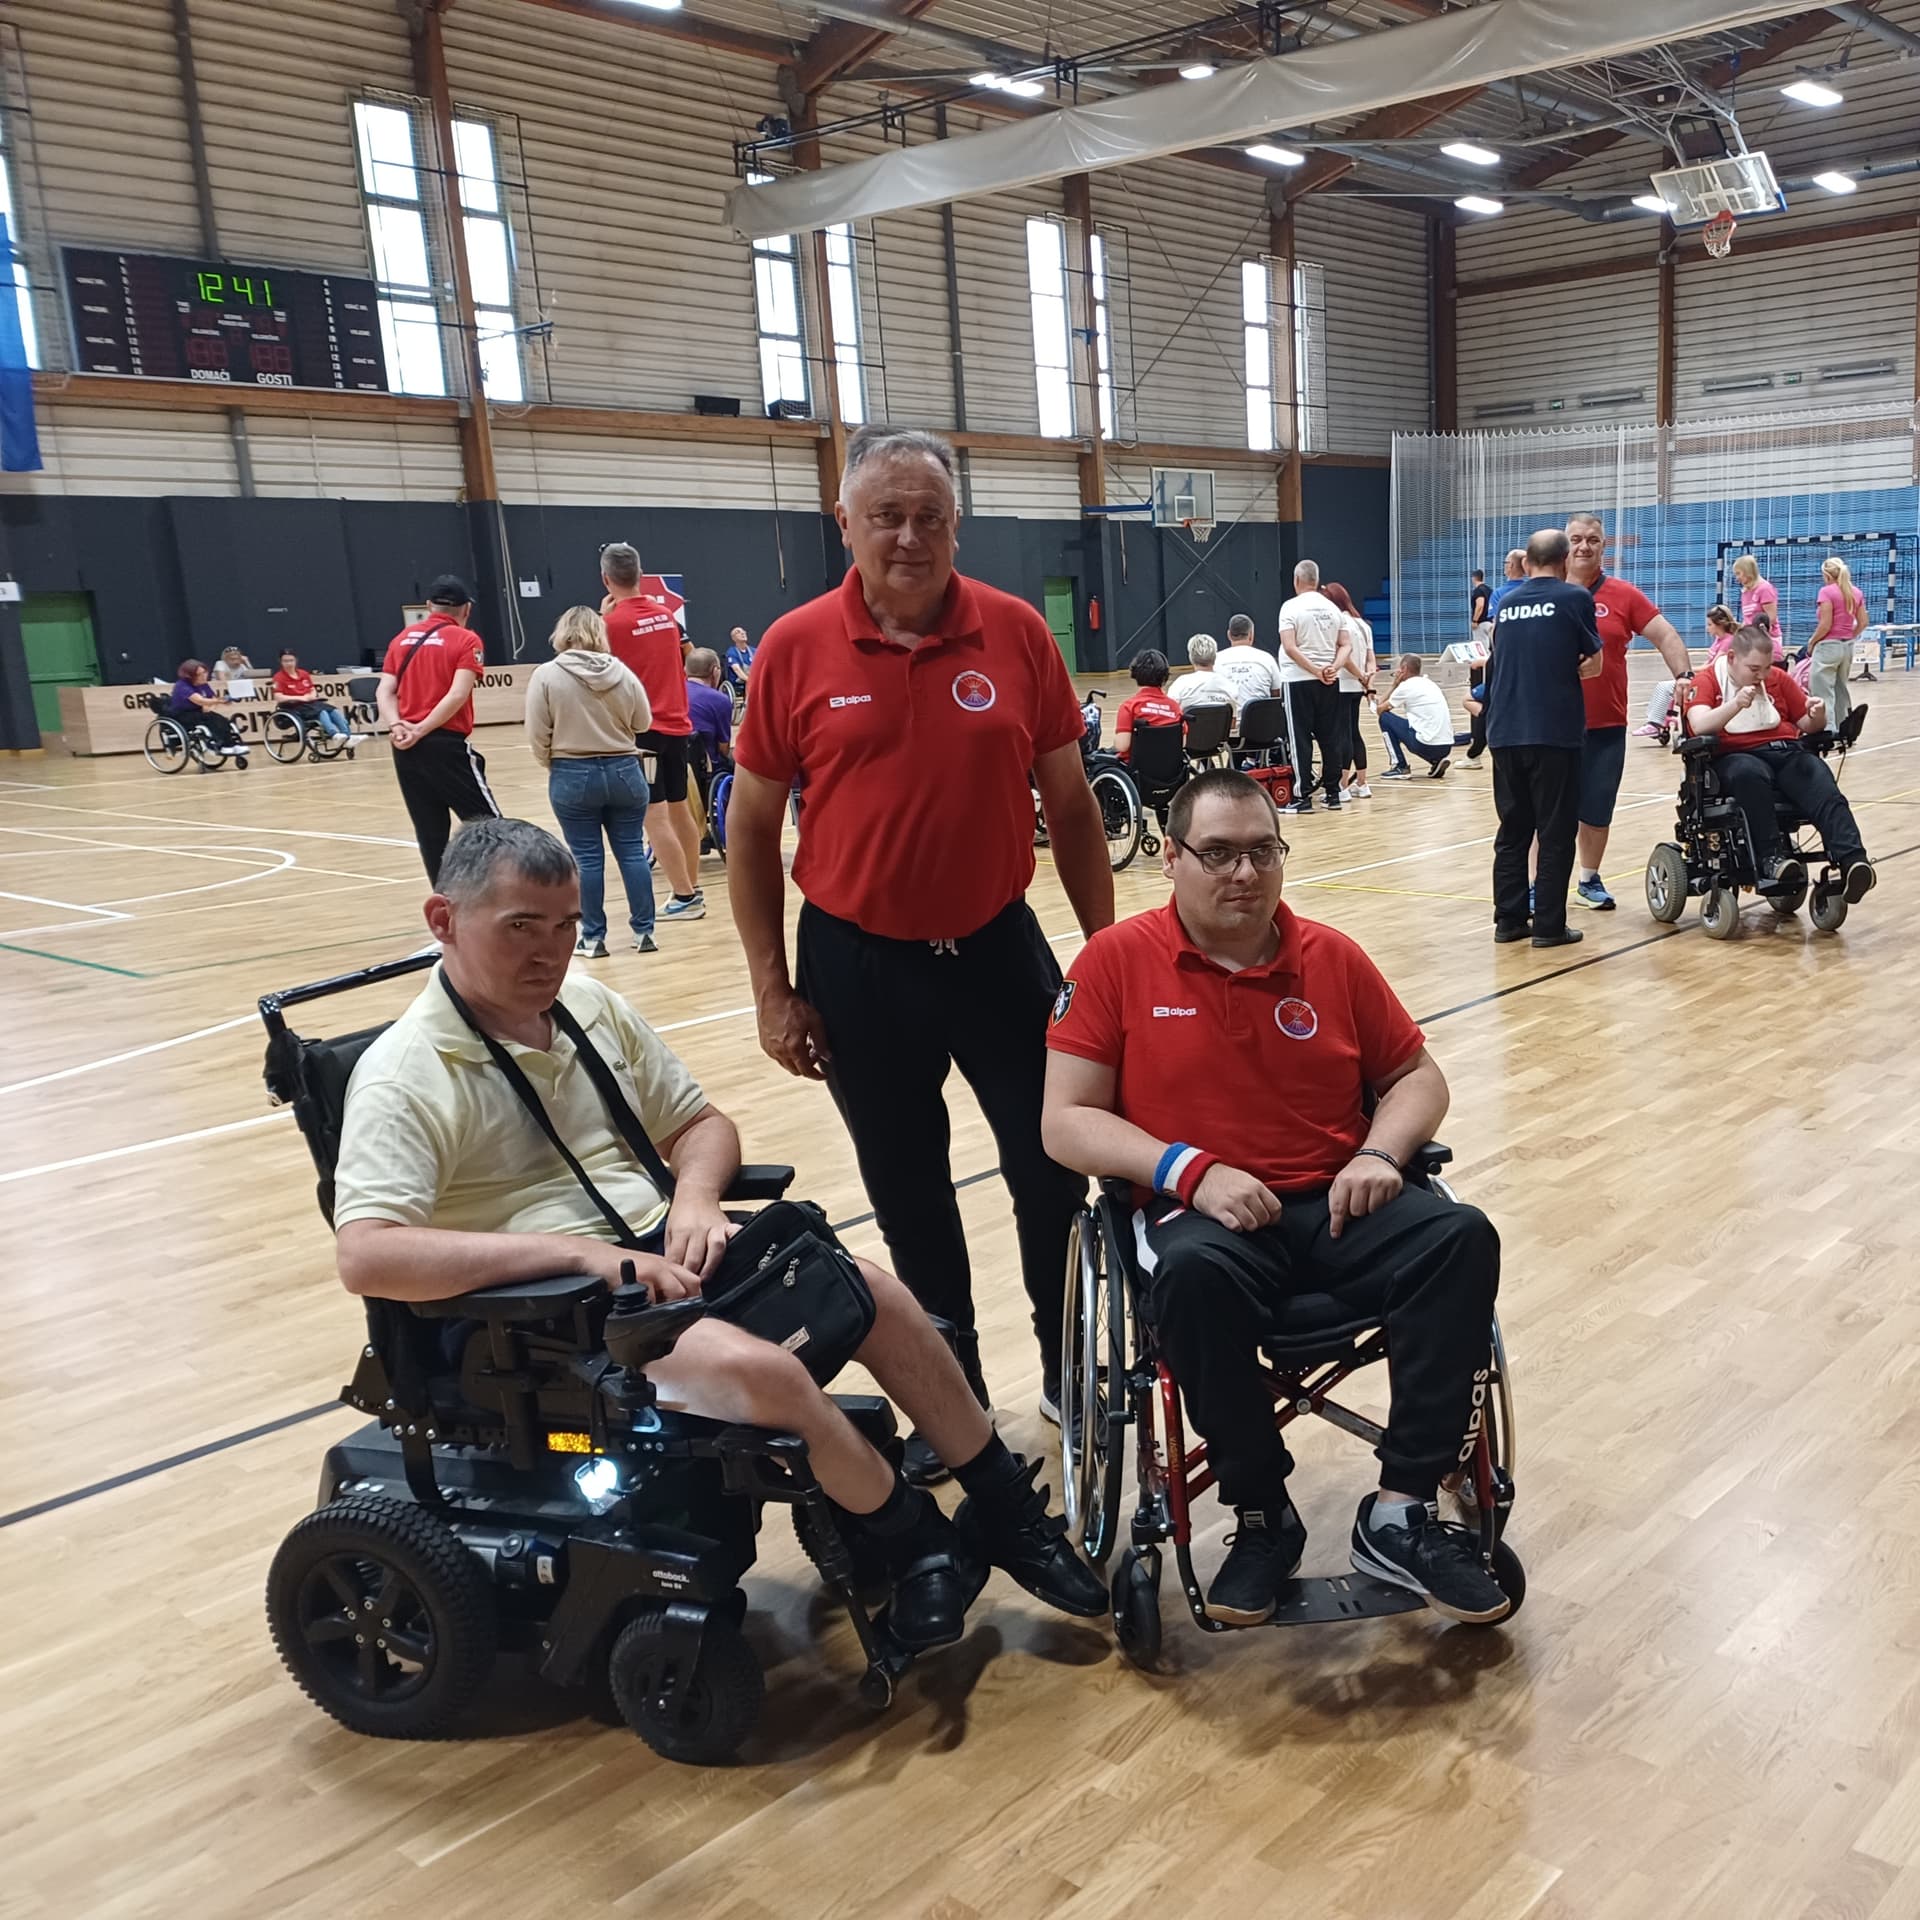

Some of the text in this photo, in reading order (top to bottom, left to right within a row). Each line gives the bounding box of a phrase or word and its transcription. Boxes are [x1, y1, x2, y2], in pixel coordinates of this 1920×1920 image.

[256, 372, 293, 386] GOSTI
[1499, 602, 1556, 623] SUDAC
[846, 694, 872, 706] alpas
[1170, 1006, 1197, 1017] alpas
[1458, 1368, 1489, 1462] alpas
